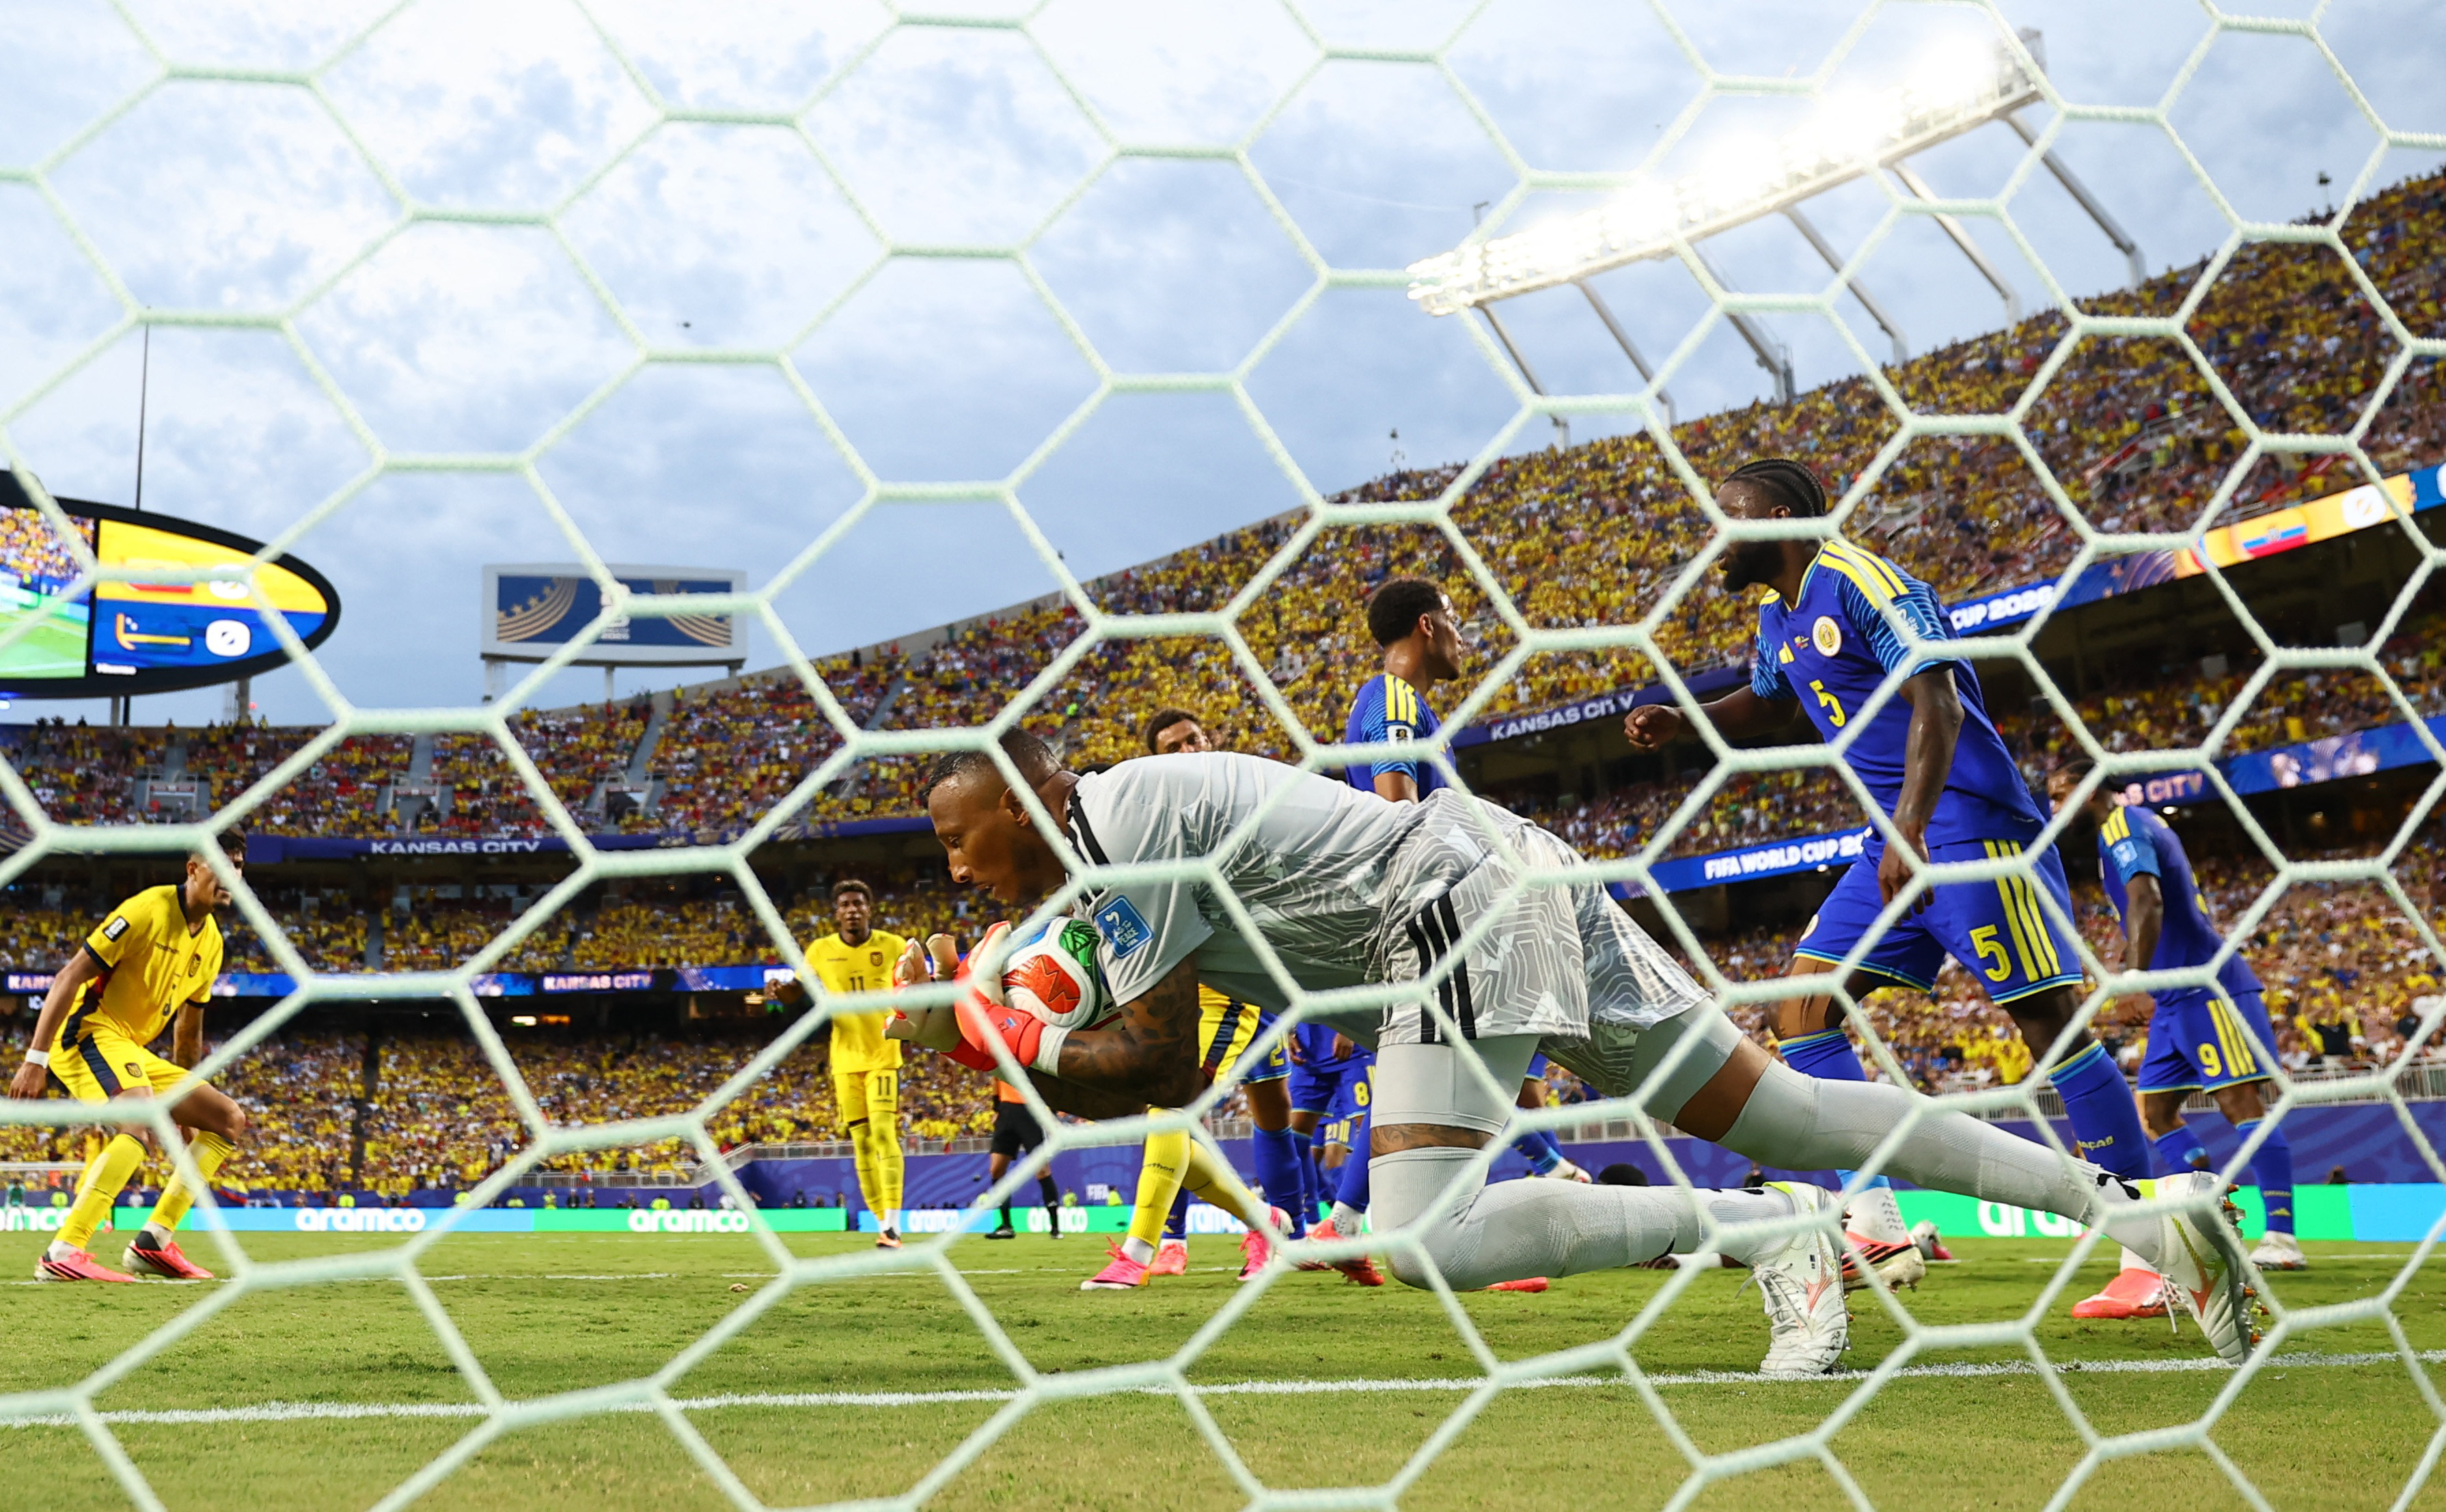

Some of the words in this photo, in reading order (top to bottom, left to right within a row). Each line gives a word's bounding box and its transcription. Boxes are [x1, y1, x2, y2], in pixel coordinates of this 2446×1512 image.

[1809, 679, 1845, 728] 5
[1490, 706, 1581, 741] KANSAS
[1583, 693, 1634, 719] CITY
[371, 841, 478, 854] KANSAS
[482, 841, 540, 853] CITY
[1704, 855, 1742, 881] FIFA
[1740, 845, 1802, 875] WORLD
[1801, 838, 1839, 864] CUP
[1969, 924, 2011, 982] 5
[543, 974, 612, 990] KANSAS
[613, 973, 652, 989] CITY
[2197, 1043, 2222, 1077] 9
[877, 1075, 891, 1097] 11
[1353, 1081, 1370, 1107] 8
[295, 1207, 426, 1231] aramco
[628, 1209, 750, 1233] aramco
